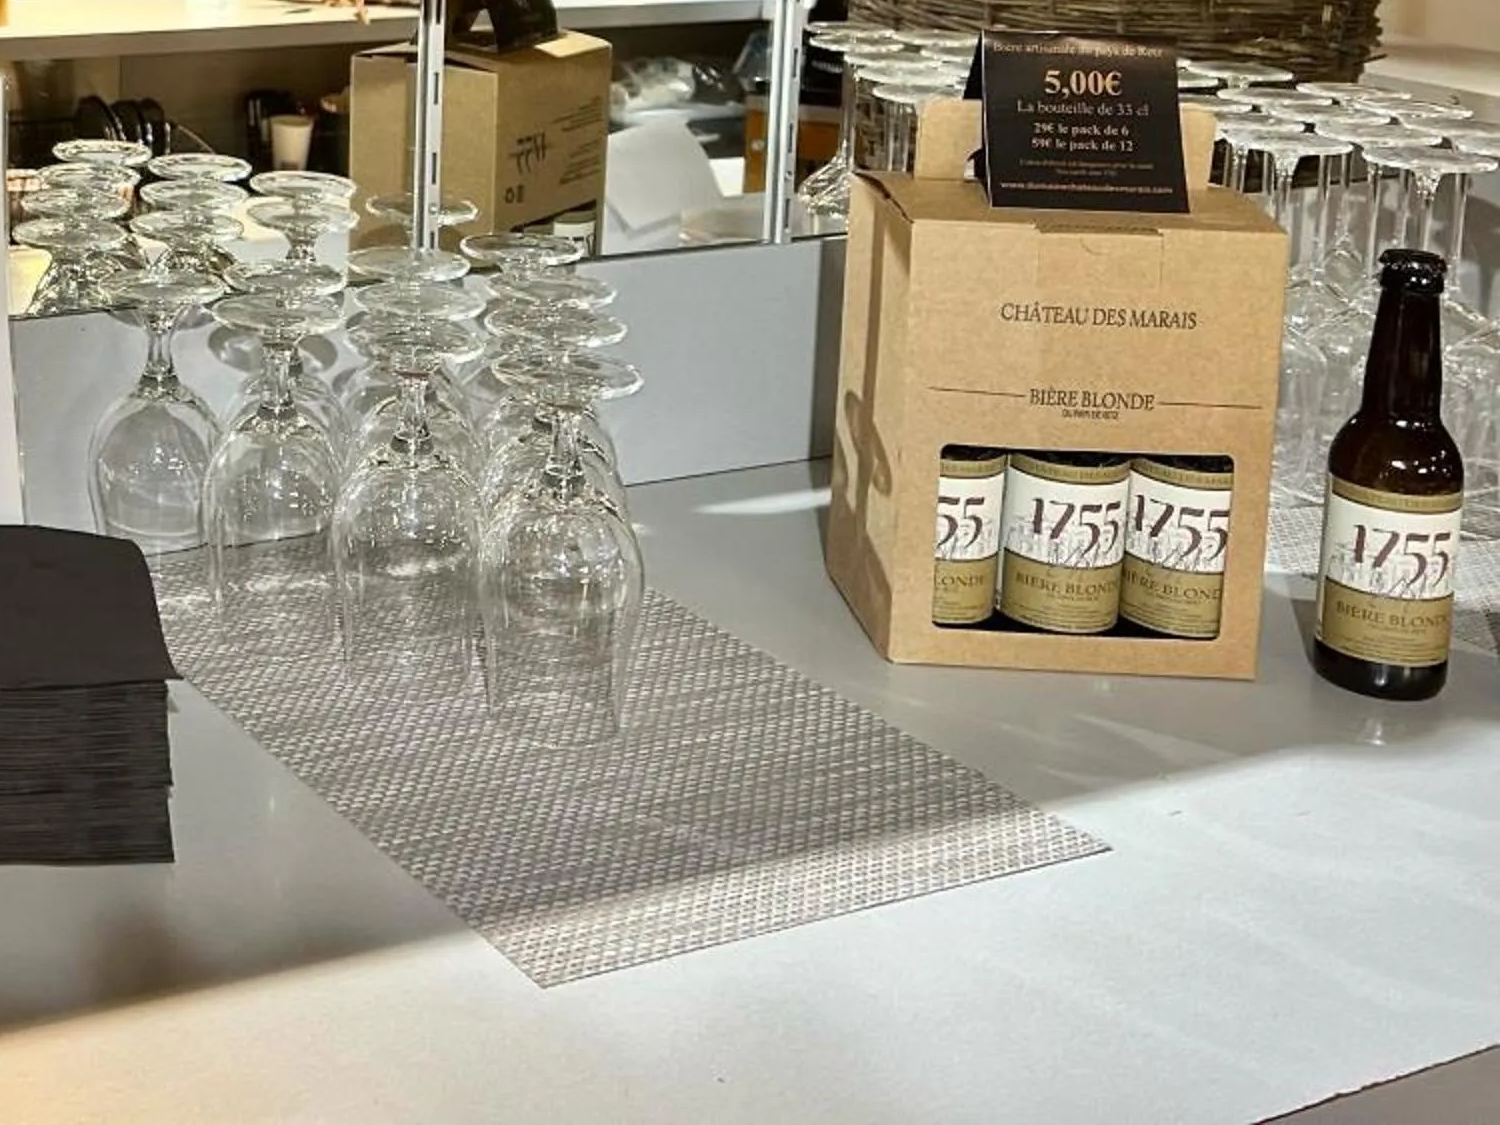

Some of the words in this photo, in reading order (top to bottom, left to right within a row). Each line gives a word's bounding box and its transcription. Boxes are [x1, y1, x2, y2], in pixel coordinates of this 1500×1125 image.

[1044, 69, 1123, 99] 5,00€
[1017, 99, 1034, 114] La
[1037, 100, 1094, 116] bouteille
[1097, 103, 1113, 116] de
[1057, 122, 1069, 135] le
[1071, 123, 1101, 137] pack
[1103, 124, 1119, 136] de
[1121, 125, 1130, 137] 6
[1055, 137, 1067, 150] le
[1069, 139, 1099, 152] pack
[1101, 139, 1116, 152] de
[1119, 140, 1134, 152] 12
[1000, 302, 1089, 326] CHÂTEAU
[1092, 307, 1127, 328] DES
[1129, 308, 1198, 330] MARAIS
[1029, 385, 1079, 407] BIÈRE
[1081, 390, 1156, 411] BLONDE
[1032, 496, 1122, 558] 1755
[1134, 493, 1231, 562] 1755
[1353, 524, 1452, 588] 1755
